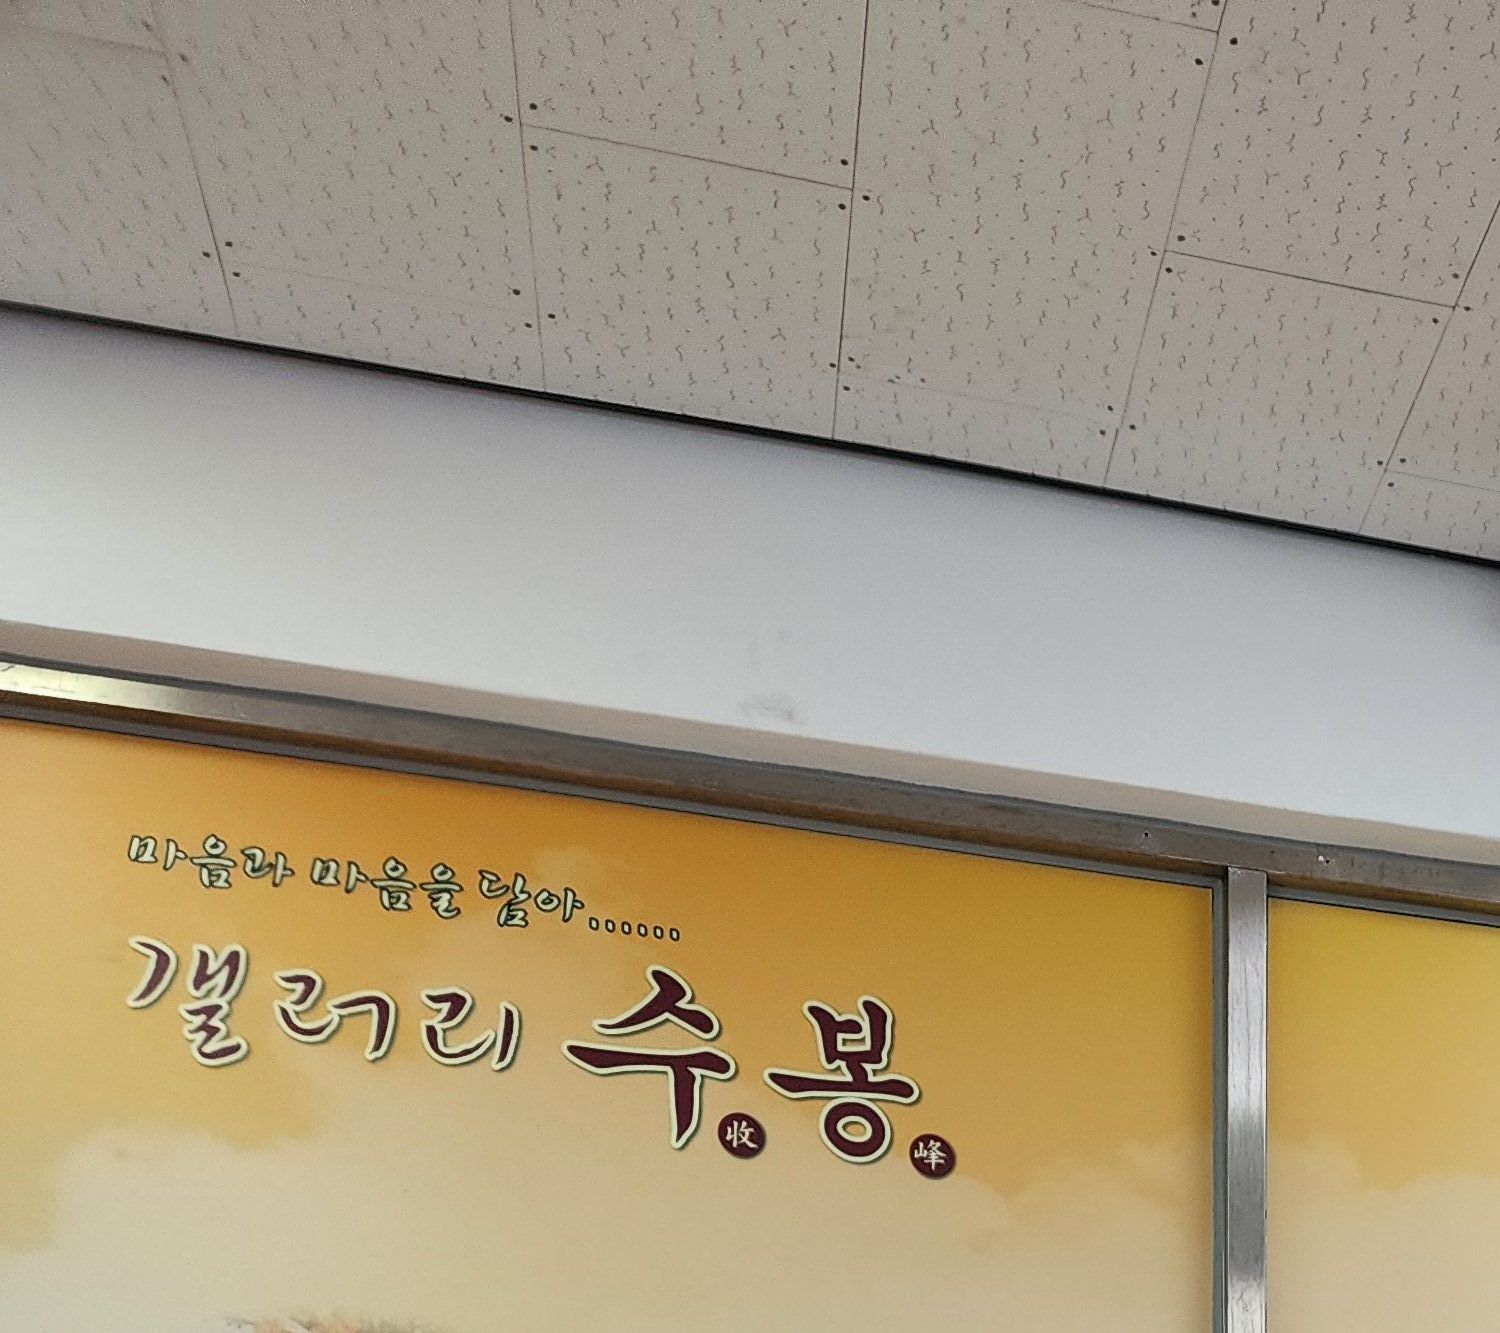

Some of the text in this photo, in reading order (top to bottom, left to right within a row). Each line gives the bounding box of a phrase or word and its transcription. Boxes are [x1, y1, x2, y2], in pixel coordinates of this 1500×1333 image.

[127, 834, 295, 889] 마음과
[310, 856, 464, 919] 마음을
[127, 936, 521, 1071] 갤러리
[722, 1117, 762, 1153] 收
[911, 1136, 951, 1175] 峰
